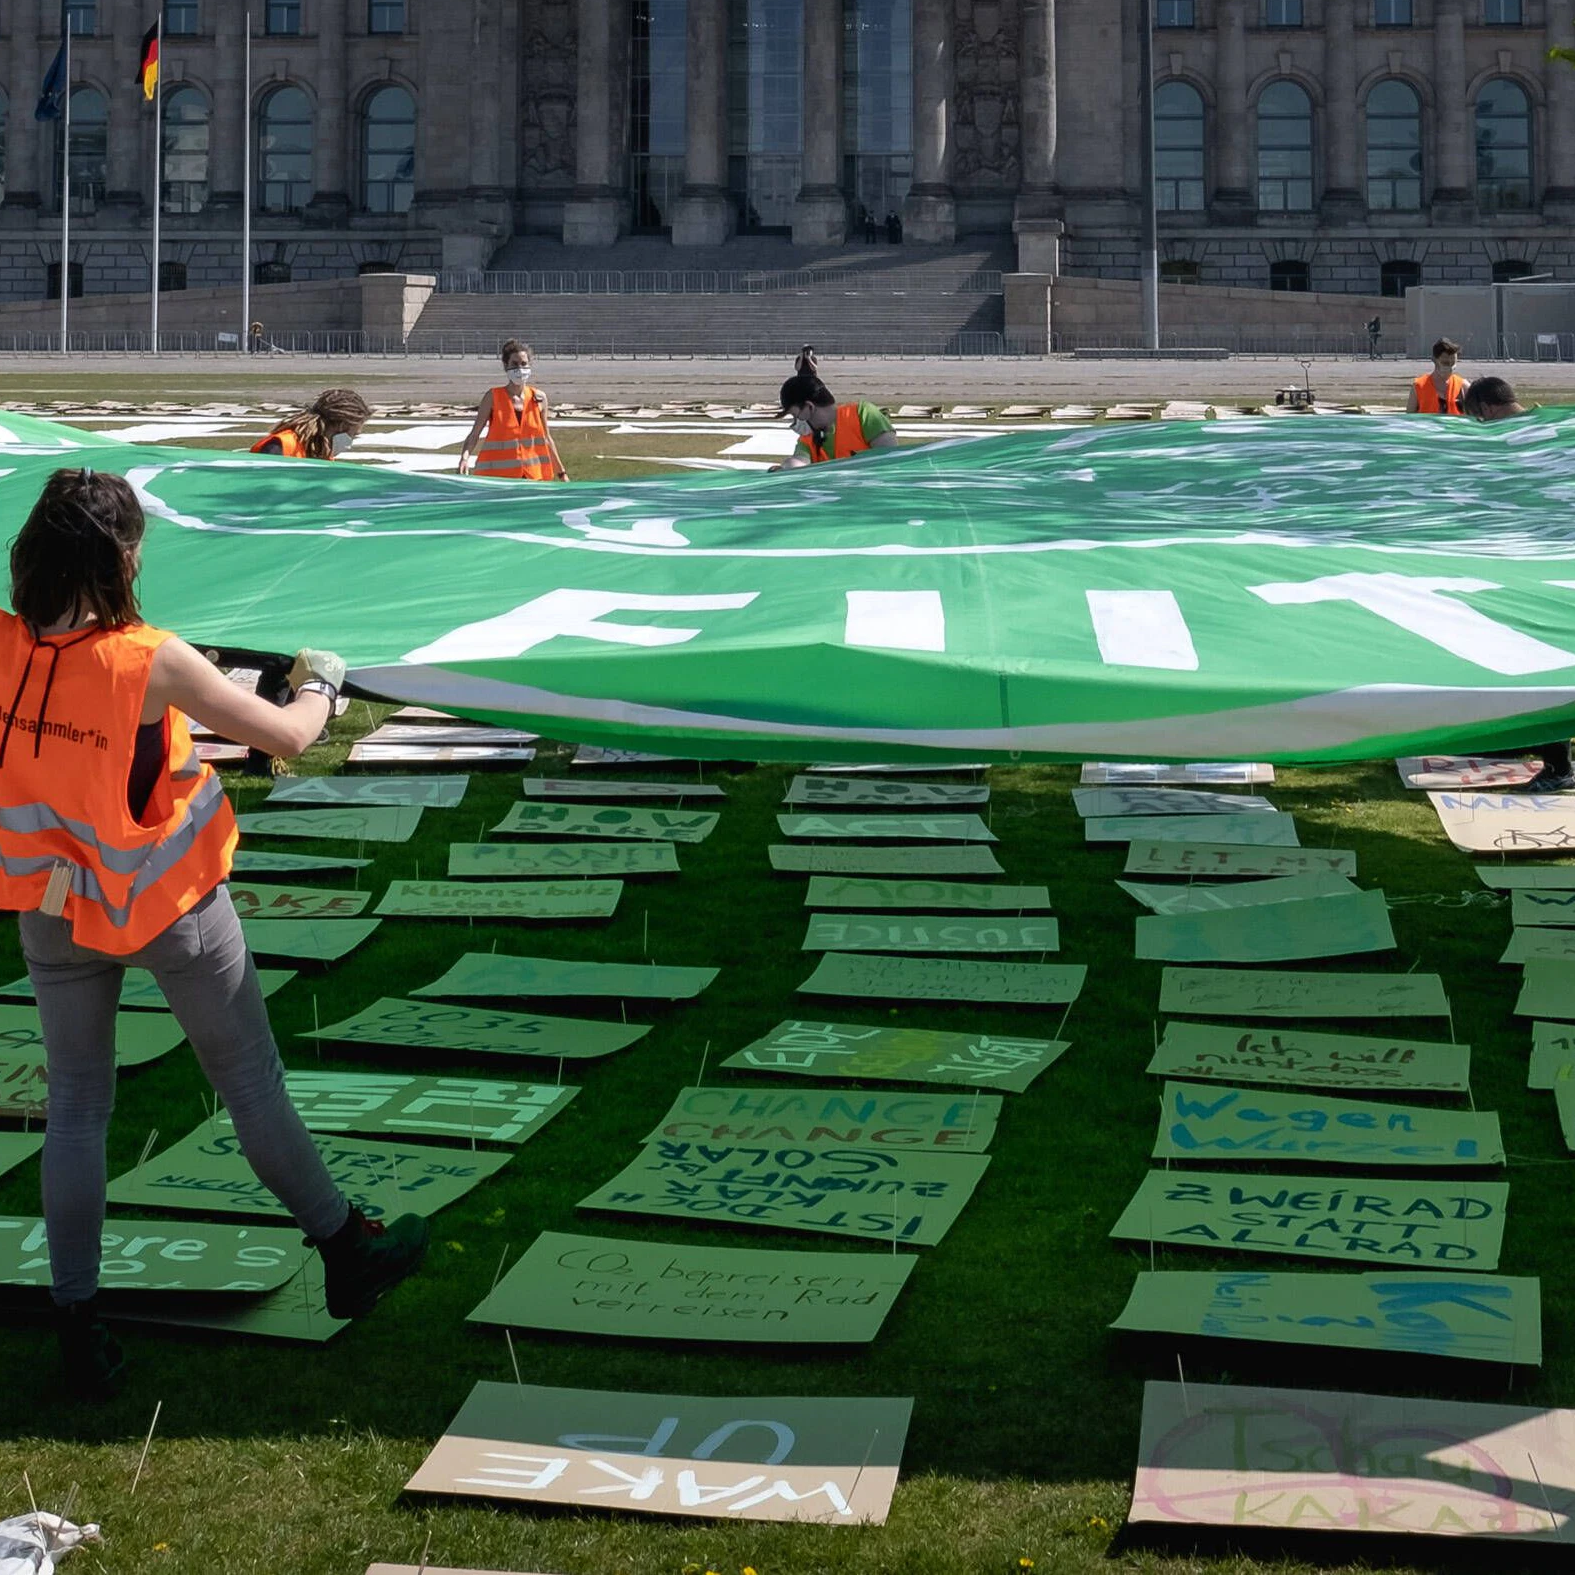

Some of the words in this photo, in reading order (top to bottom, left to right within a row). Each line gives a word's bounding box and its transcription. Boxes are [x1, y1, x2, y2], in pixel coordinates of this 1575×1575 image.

[232, 890, 368, 910] AKE
[1162, 1181, 1493, 1220] ZWEIRAD
[1216, 1210, 1440, 1239] STATT
[1165, 1225, 1479, 1262] ALLRAD
[575, 1277, 649, 1295] mit
[682, 1285, 766, 1303] dem
[794, 1286, 880, 1307] Rad
[556, 1417, 798, 1466] UP
[452, 1451, 854, 1516] WAKE
